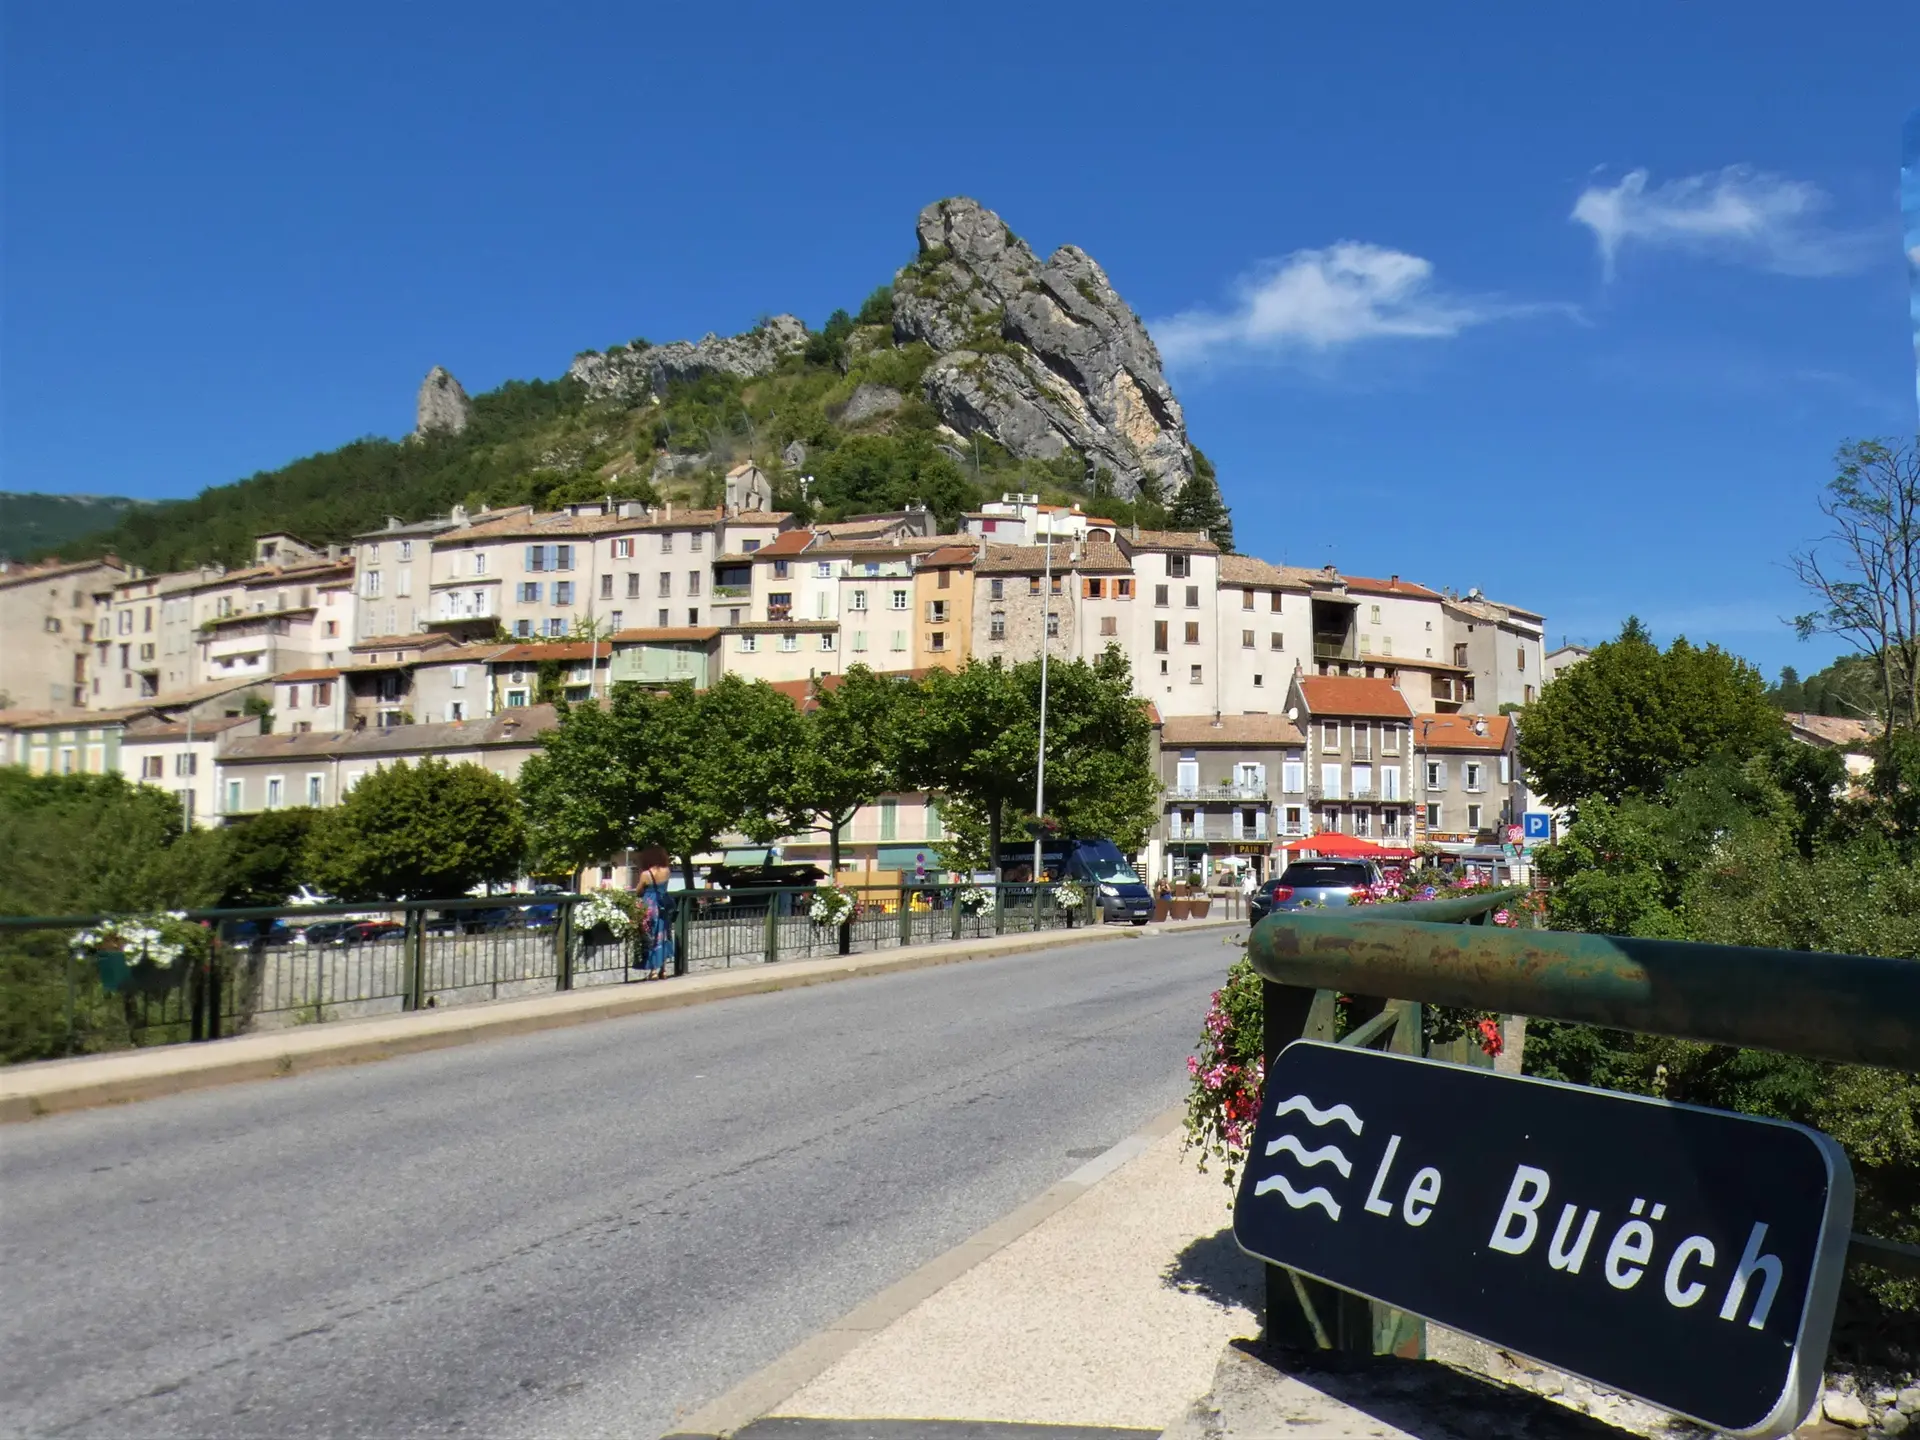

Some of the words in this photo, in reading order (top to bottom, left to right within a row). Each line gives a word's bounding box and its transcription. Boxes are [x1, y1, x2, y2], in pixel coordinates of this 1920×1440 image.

[1530, 817, 1543, 834] P
[1239, 845, 1260, 853] PAIN
[1364, 1134, 1442, 1227] Le
[1488, 1164, 1784, 1330] Buëch
